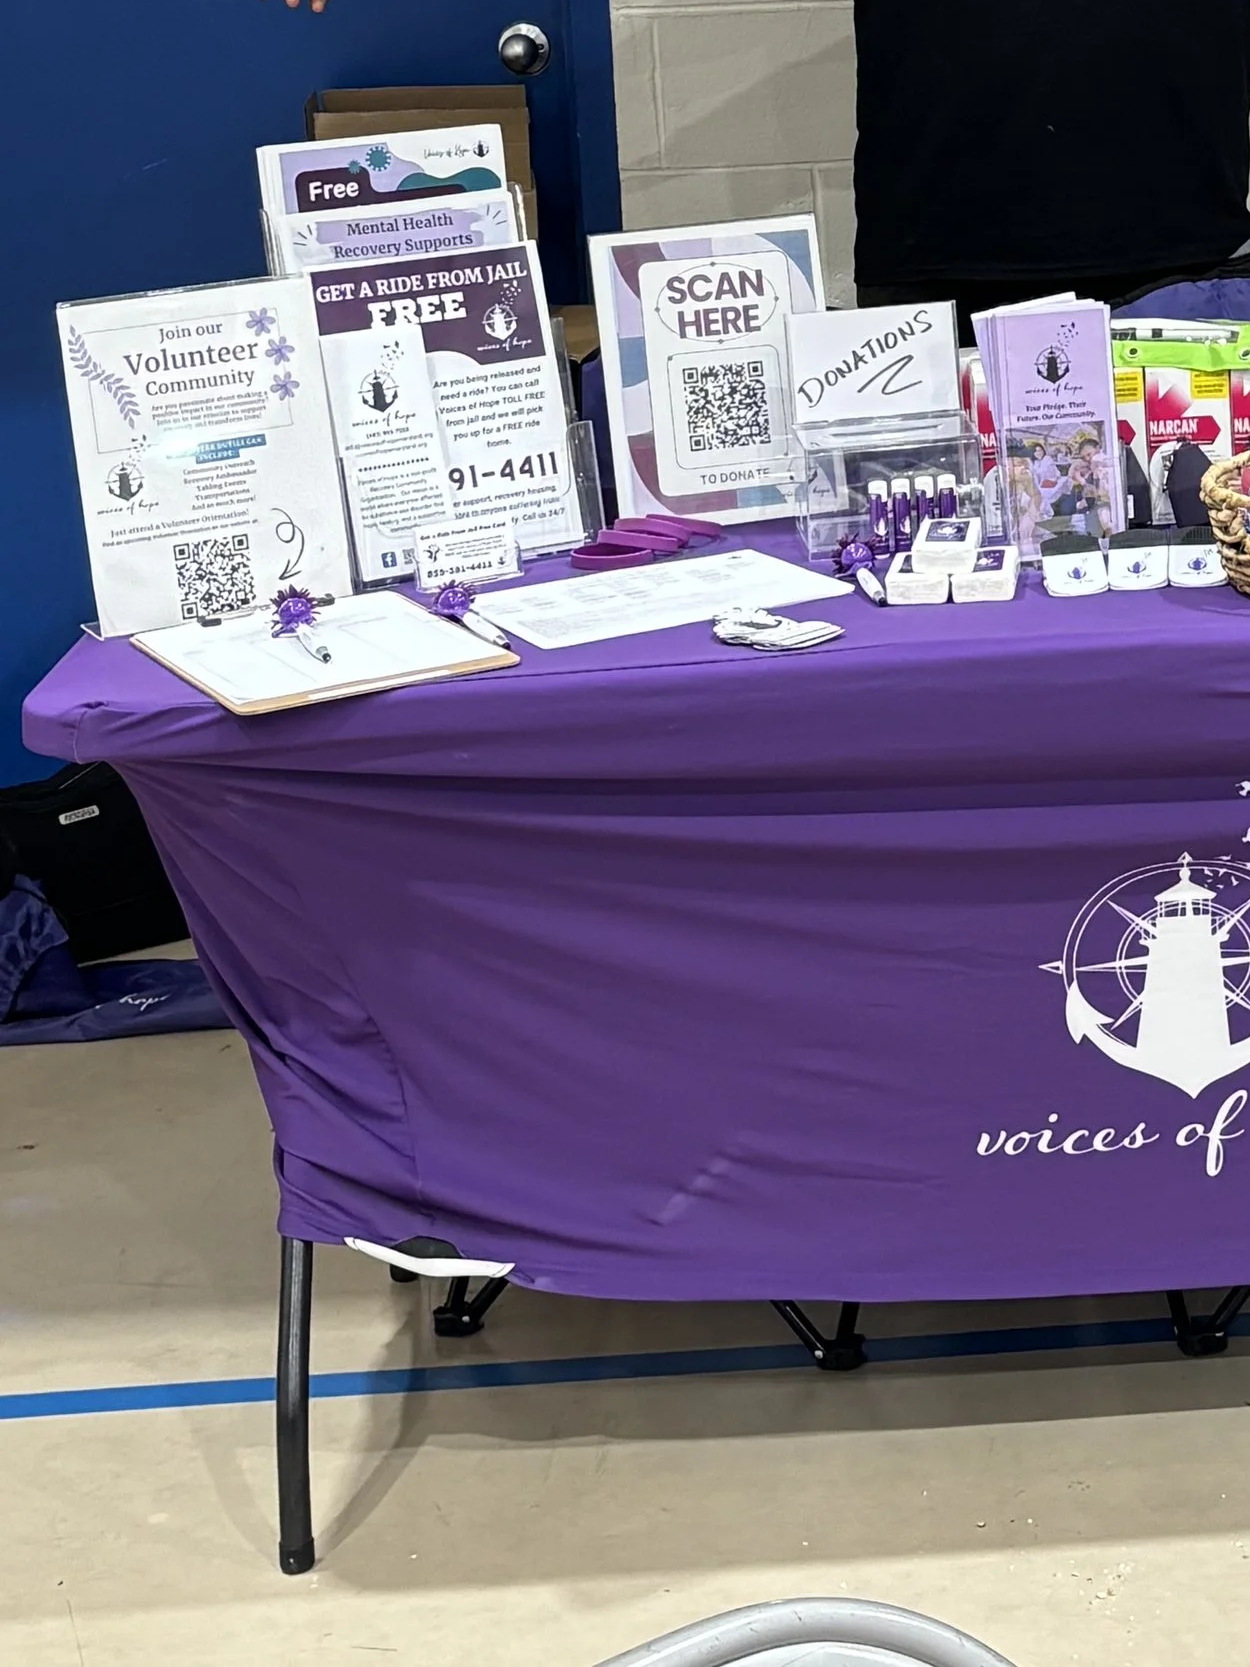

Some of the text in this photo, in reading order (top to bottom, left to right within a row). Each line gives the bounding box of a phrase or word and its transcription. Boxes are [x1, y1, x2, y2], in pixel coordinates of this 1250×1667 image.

[308, 181, 360, 202] Free
[347, 213, 453, 236] Mental Health
[333, 233, 473, 260] Recovery Supports
[316, 261, 528, 303] GET A RIDE FROM JAIL
[667, 269, 764, 305] SCAN
[367, 291, 467, 329] FREE
[159, 322, 223, 344] Join our
[677, 304, 762, 340] HERE
[501, 337, 511, 352] of
[512, 337, 532, 348] hope
[123, 341, 259, 376] Volunteer
[797, 309, 933, 409] DONATIONS
[146, 369, 255, 397] Community
[433, 365, 541, 389] Are you being released and
[440, 391, 460, 401] need
[491, 384, 506, 393] You
[508, 383, 524, 391] can
[525, 379, 539, 389] call
[1052, 383, 1061, 397] of
[1063, 382, 1083, 395] hope
[438, 404, 466, 415] Voices
[479, 399, 500, 409] Hope
[502, 394, 523, 404] TOLL
[525, 391, 545, 401] FREE
[382, 412, 391, 427] of
[394, 410, 416, 425] hope
[446, 418, 465, 427] from
[482, 413, 496, 423] and
[511, 407, 525, 417] will
[526, 405, 543, 416] pick
[1149, 419, 1199, 435] NARCAN
[453, 419, 540, 442] you up for FREE ride
[448, 451, 558, 490] 91-4411
[700, 467, 770, 485] TO DONATE
[126, 501, 136, 516] of
[138, 499, 159, 512] hope
[976, 1112, 1160, 1156] voices
[1175, 1089, 1248, 1177] of
